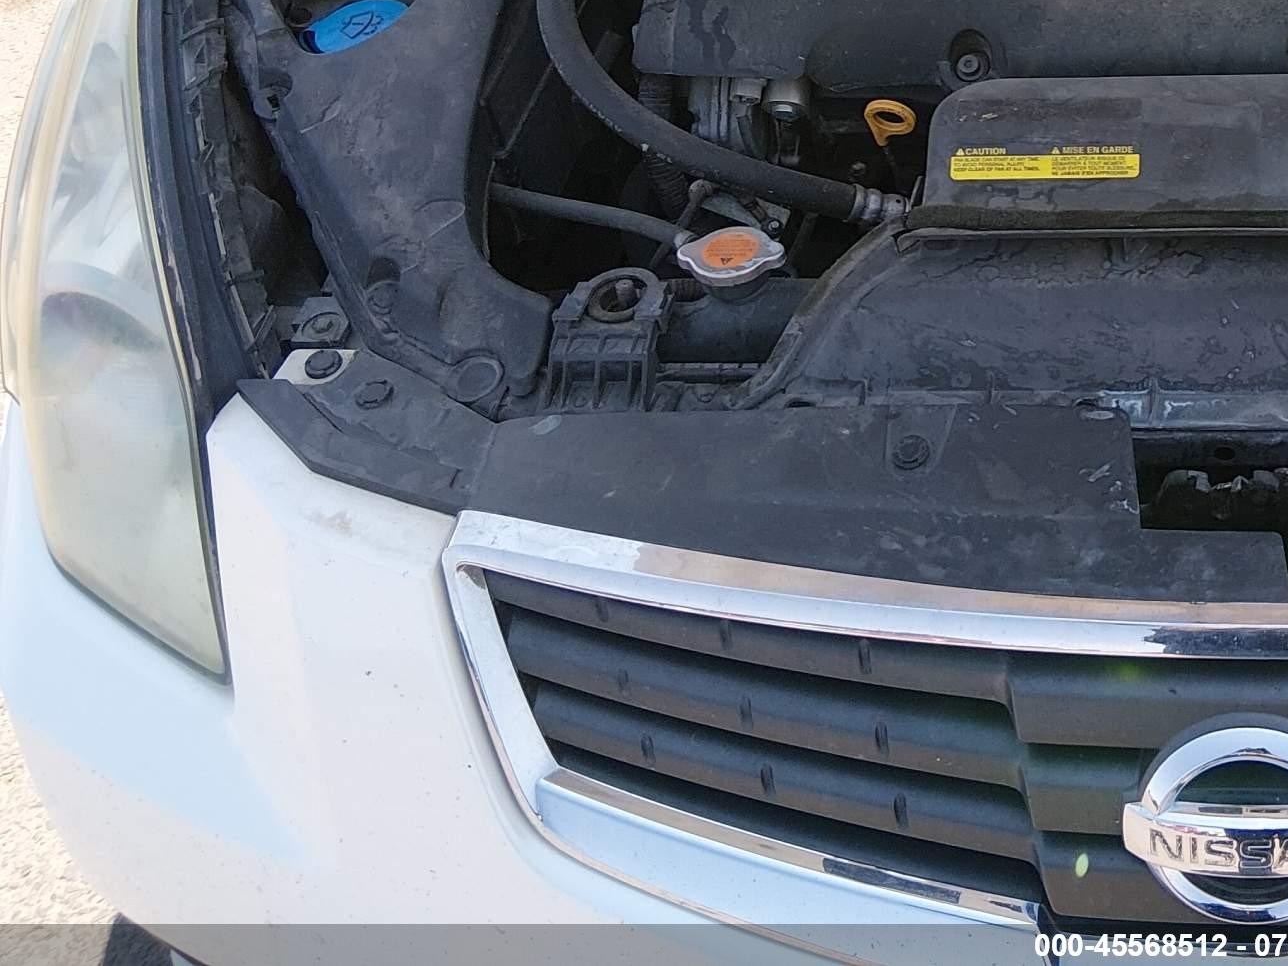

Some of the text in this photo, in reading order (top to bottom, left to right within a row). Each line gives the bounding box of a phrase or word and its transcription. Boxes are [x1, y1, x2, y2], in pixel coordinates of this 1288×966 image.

[965, 147, 1006, 155] CAUTION
[1062, 145, 1134, 154] MISE EN GARDE
